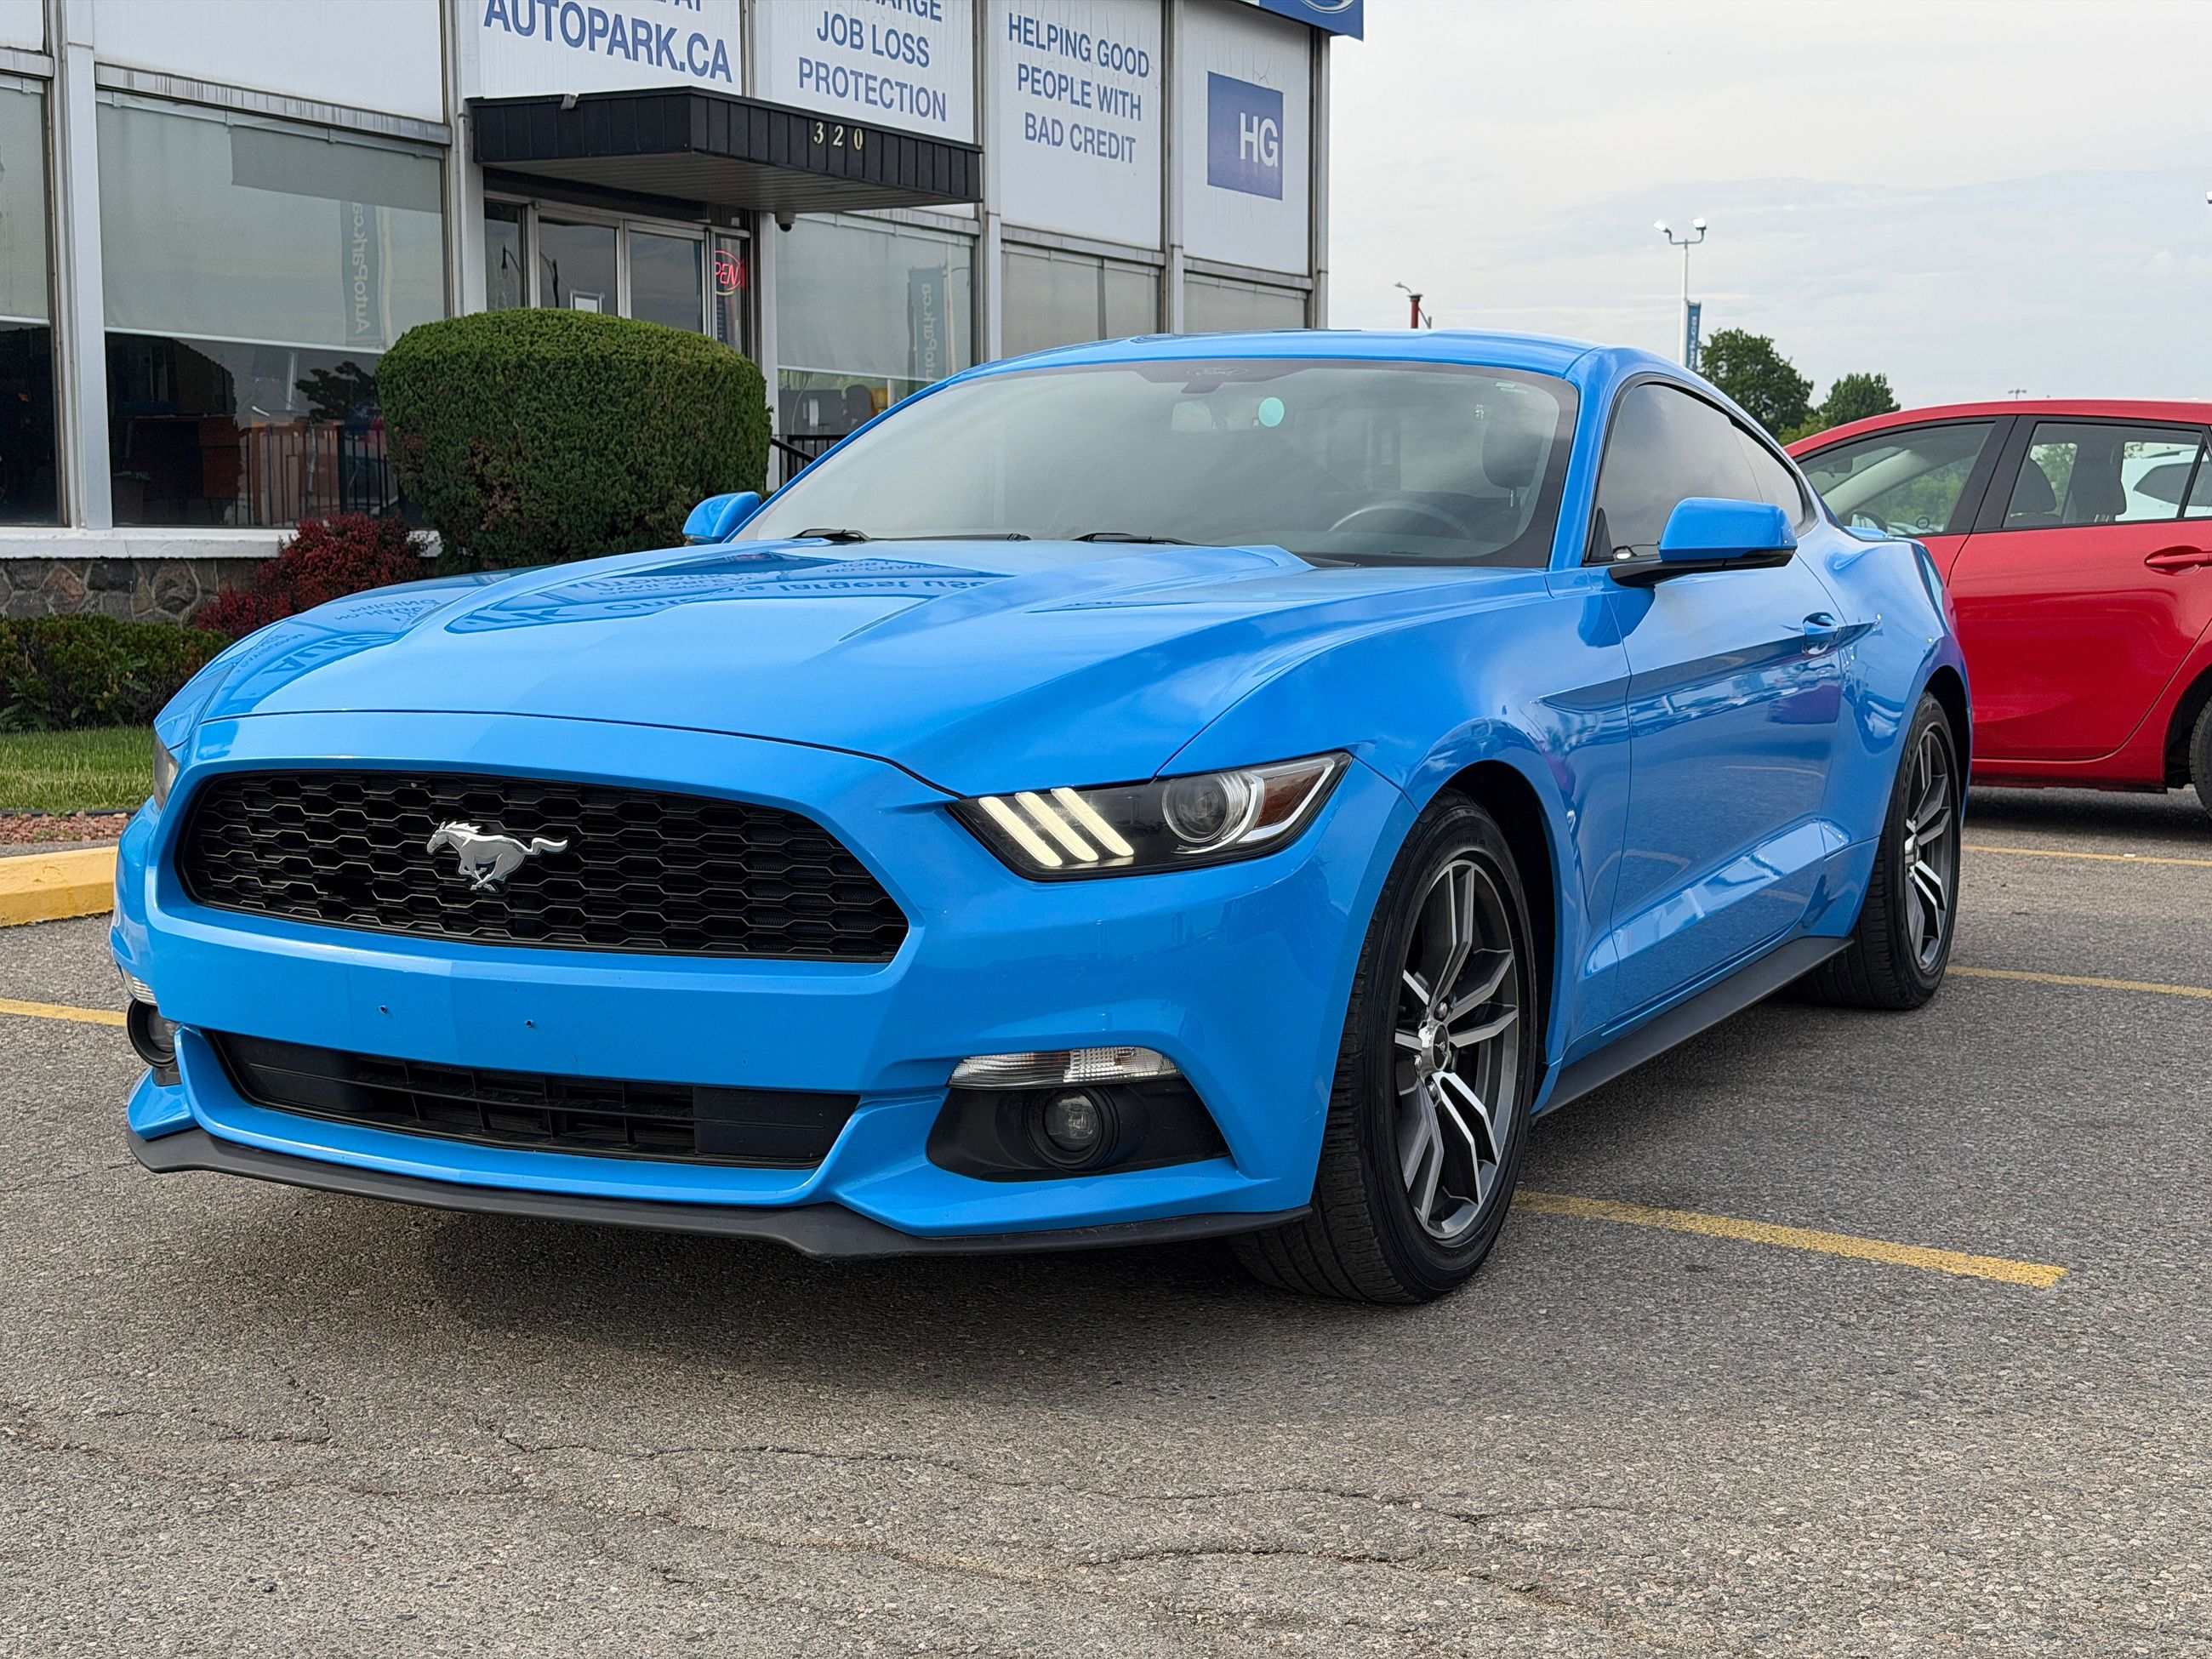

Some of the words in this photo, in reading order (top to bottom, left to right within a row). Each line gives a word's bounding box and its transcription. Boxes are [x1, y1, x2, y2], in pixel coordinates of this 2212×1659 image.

[483, 0, 733, 83] AUTOPARK.CA
[817, 11, 864, 50] JOB
[872, 24, 930, 68] LOSS
[1008, 13, 1091, 62] HELPING
[1097, 39, 1150, 77] GOOD
[799, 56, 946, 122] PROTECTION
[1018, 63, 1092, 109] PEOPLE
[1097, 83, 1142, 121] WITH
[813, 122, 864, 151] 320
[1024, 111, 1063, 146] BAD
[1069, 123, 1136, 163] CREDIT
[1240, 112, 1279, 167] HG
[715, 261, 739, 286] PEN
